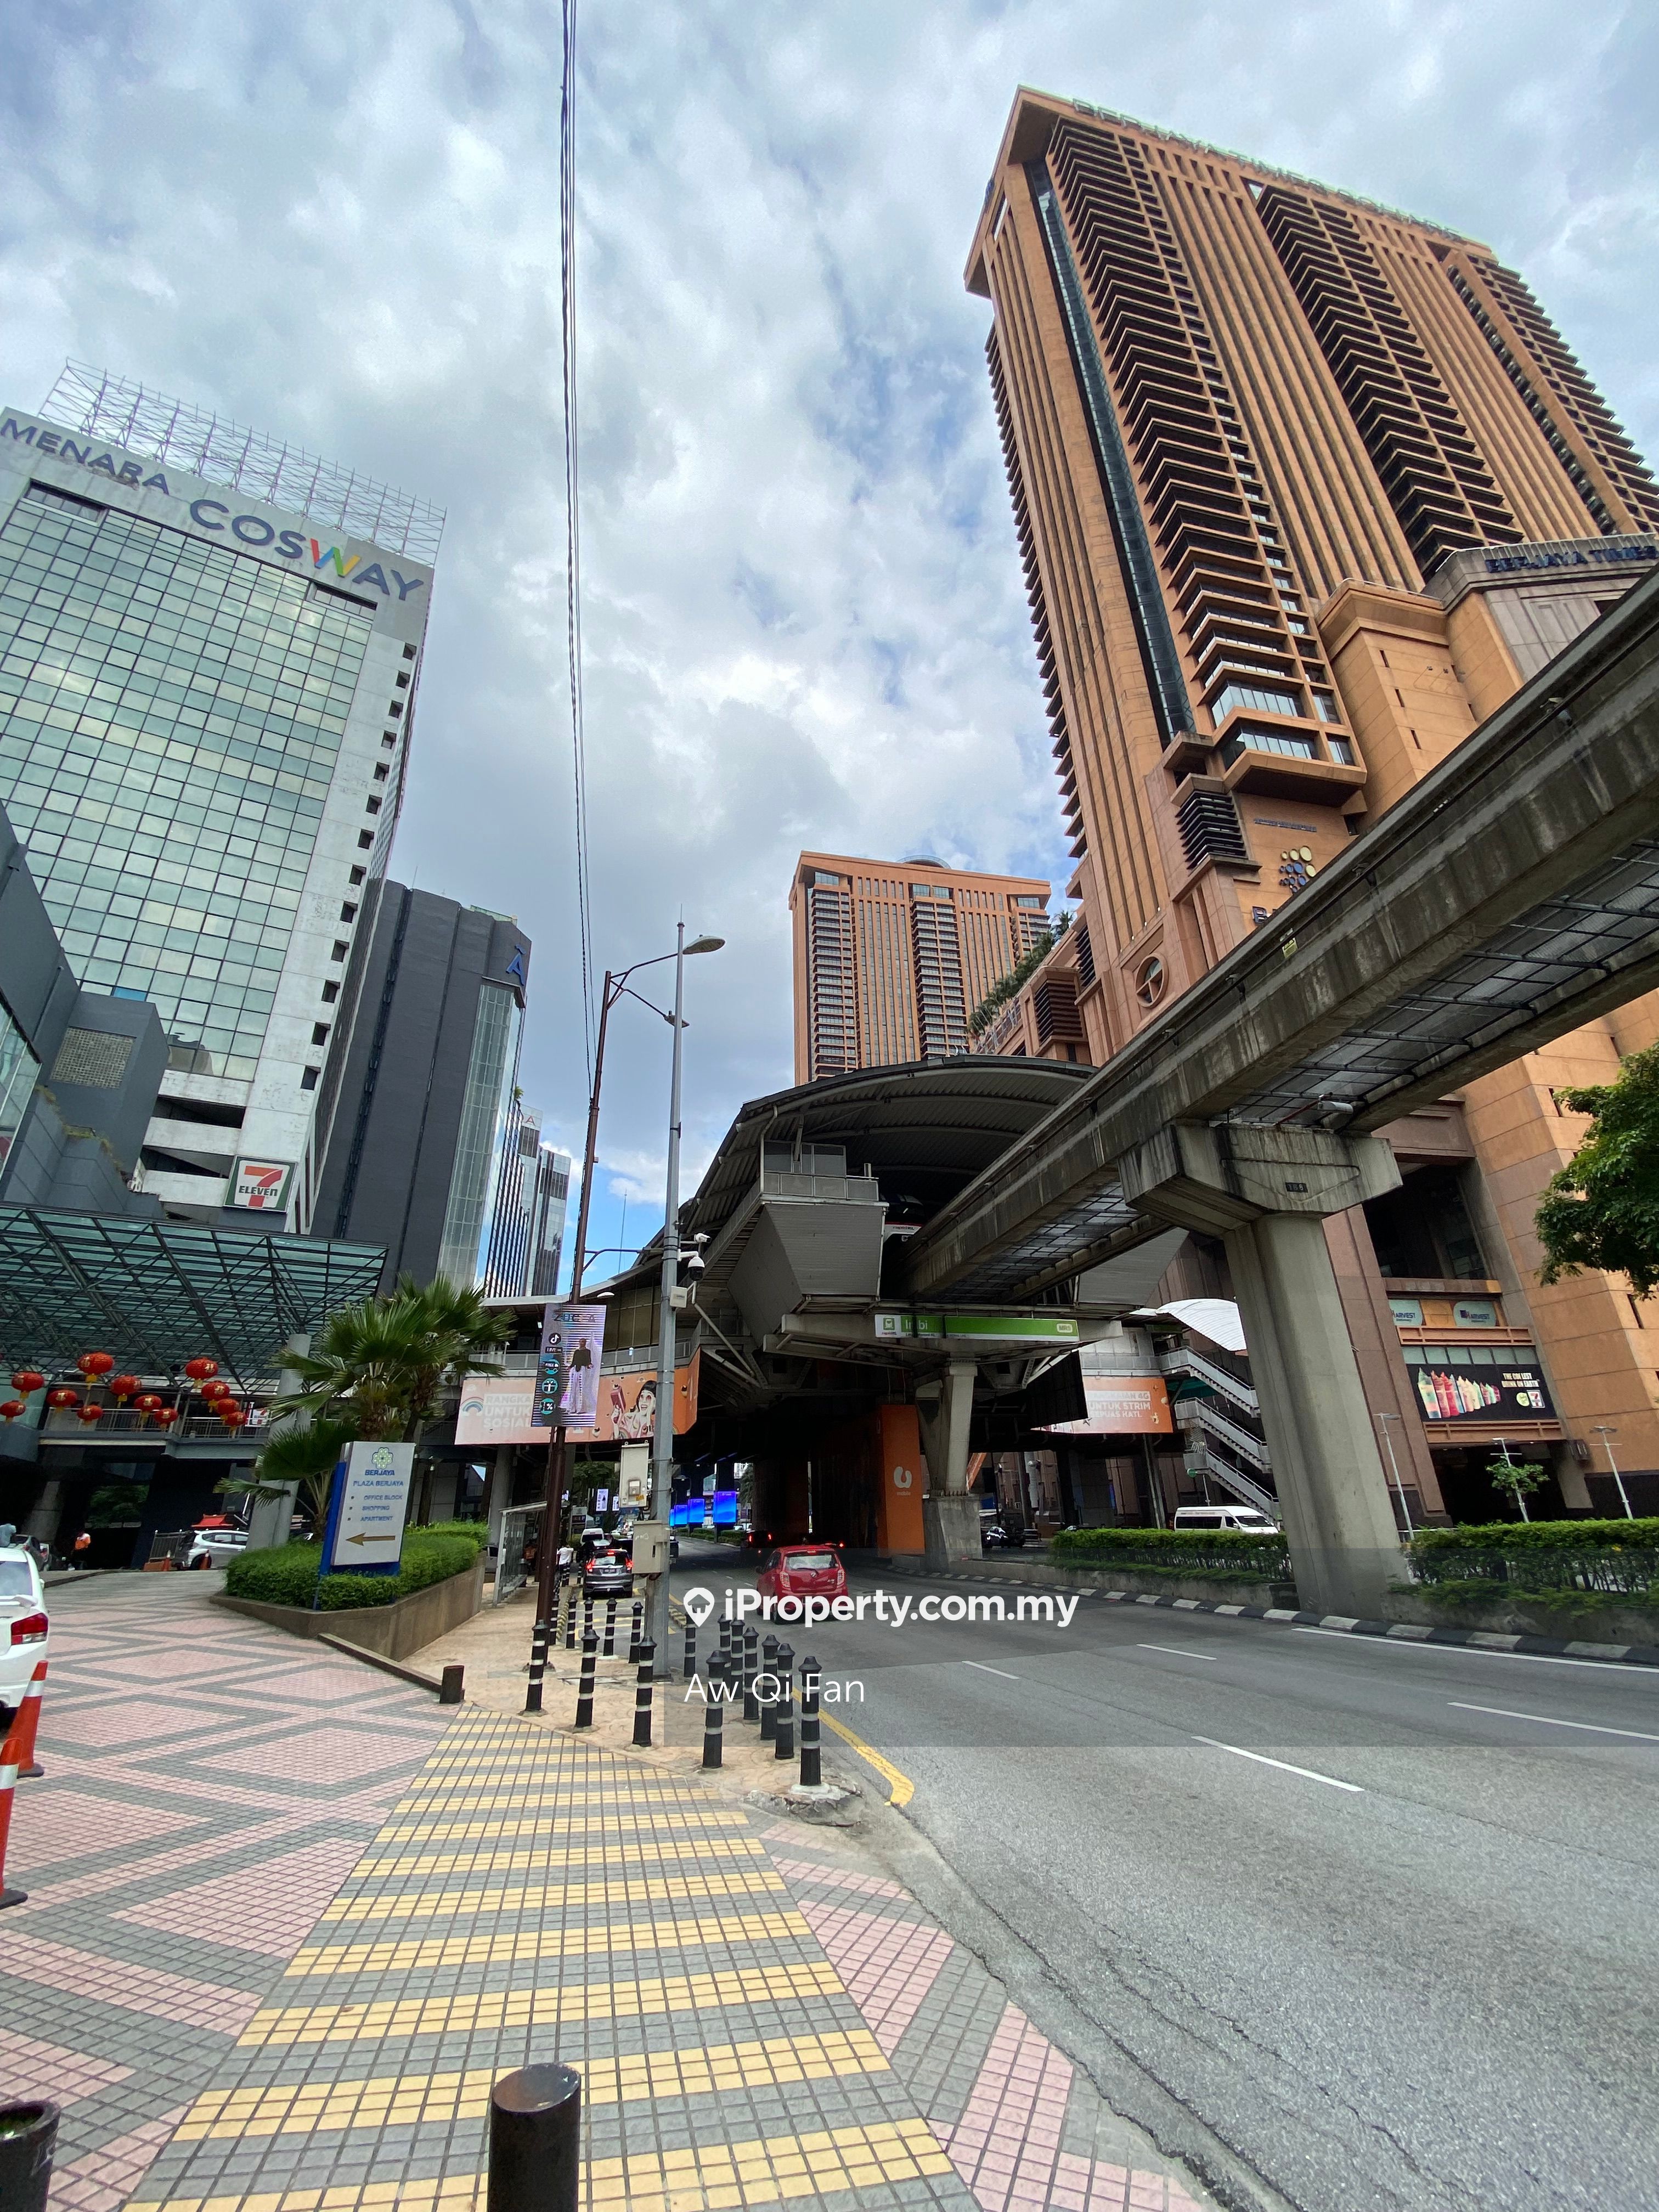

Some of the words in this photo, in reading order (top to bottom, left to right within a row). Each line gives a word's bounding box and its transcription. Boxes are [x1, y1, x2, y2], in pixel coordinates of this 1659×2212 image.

[1, 418, 170, 495] MENARA
[189, 499, 424, 601] COSWAY
[244, 1166, 283, 1207] 7
[1089, 1402, 1121, 1410] UNTUK
[1123, 1402, 1151, 1410] STRIM
